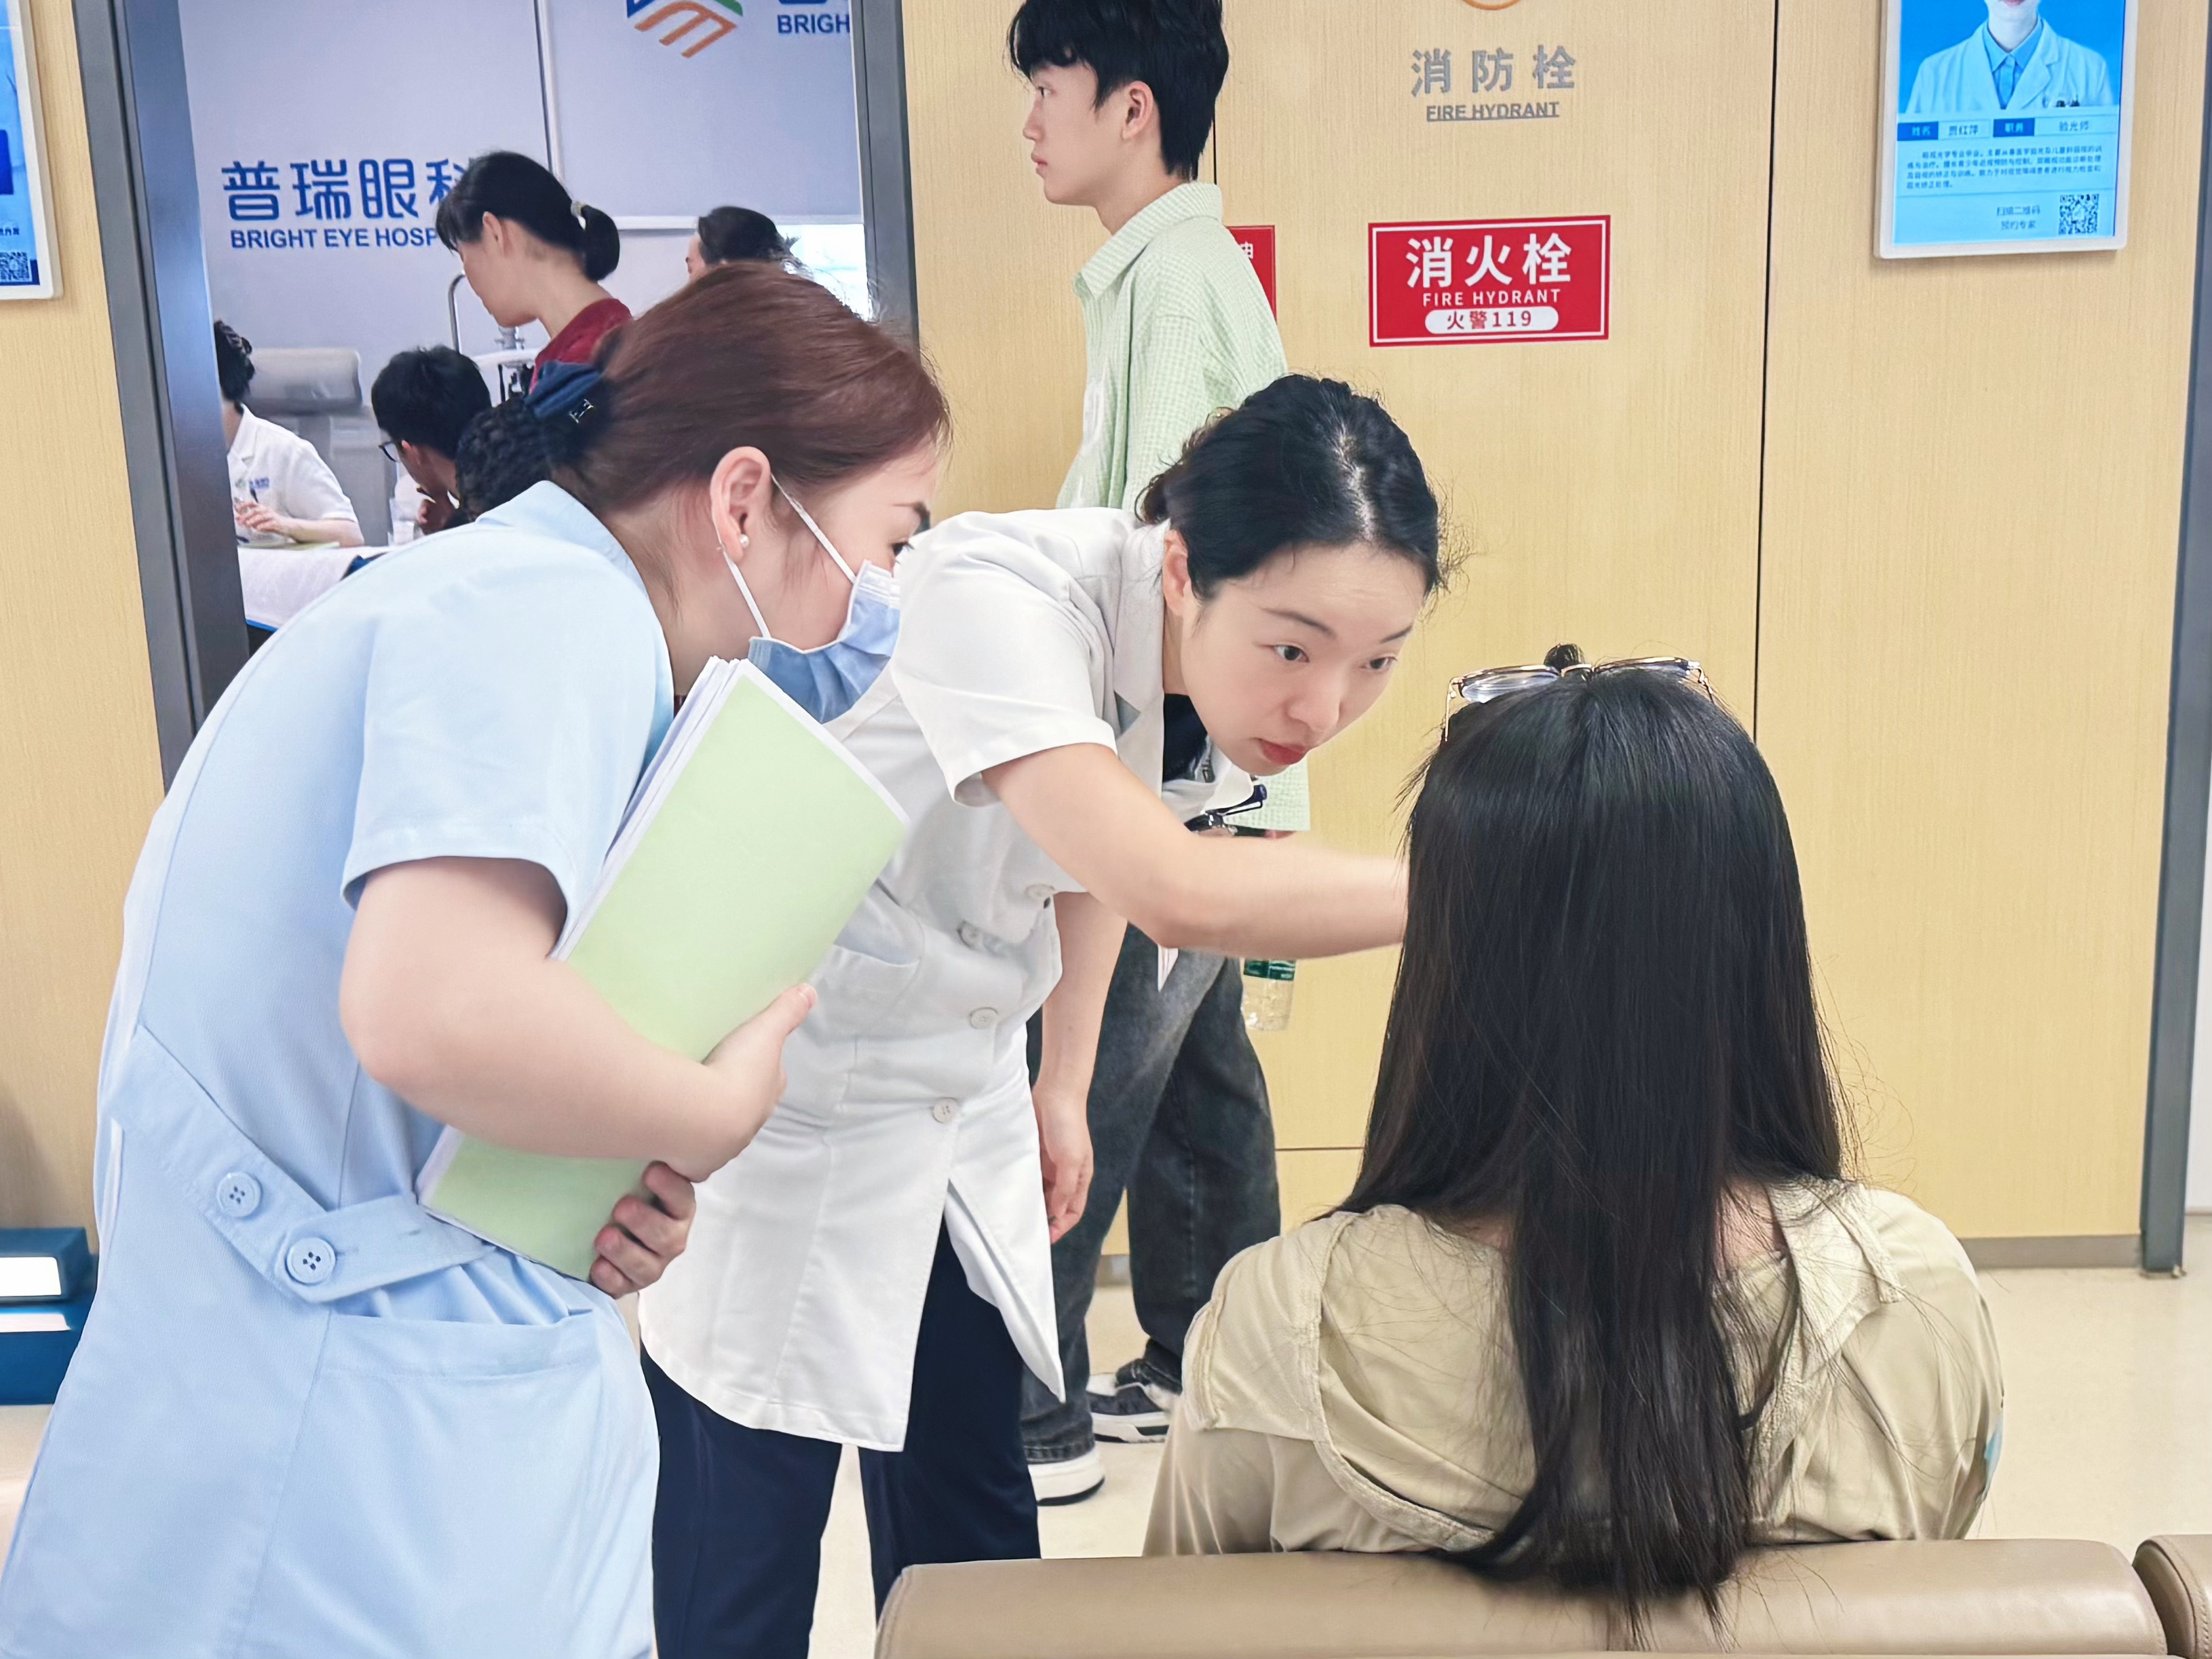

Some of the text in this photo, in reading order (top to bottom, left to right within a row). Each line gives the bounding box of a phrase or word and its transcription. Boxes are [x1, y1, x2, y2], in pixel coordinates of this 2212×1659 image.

[777, 14, 850, 33] BRIGH
[1411, 44, 1576, 97] 消防栓
[1426, 102, 1560, 121] FIRE HYDRANT
[231, 229, 317, 248] BRIGHT
[324, 228, 369, 248] EYE
[1406, 233, 1571, 288] 消火栓
[1423, 289, 1561, 307] FIRE HYDRANT
[1447, 310, 1531, 330] 火警119
